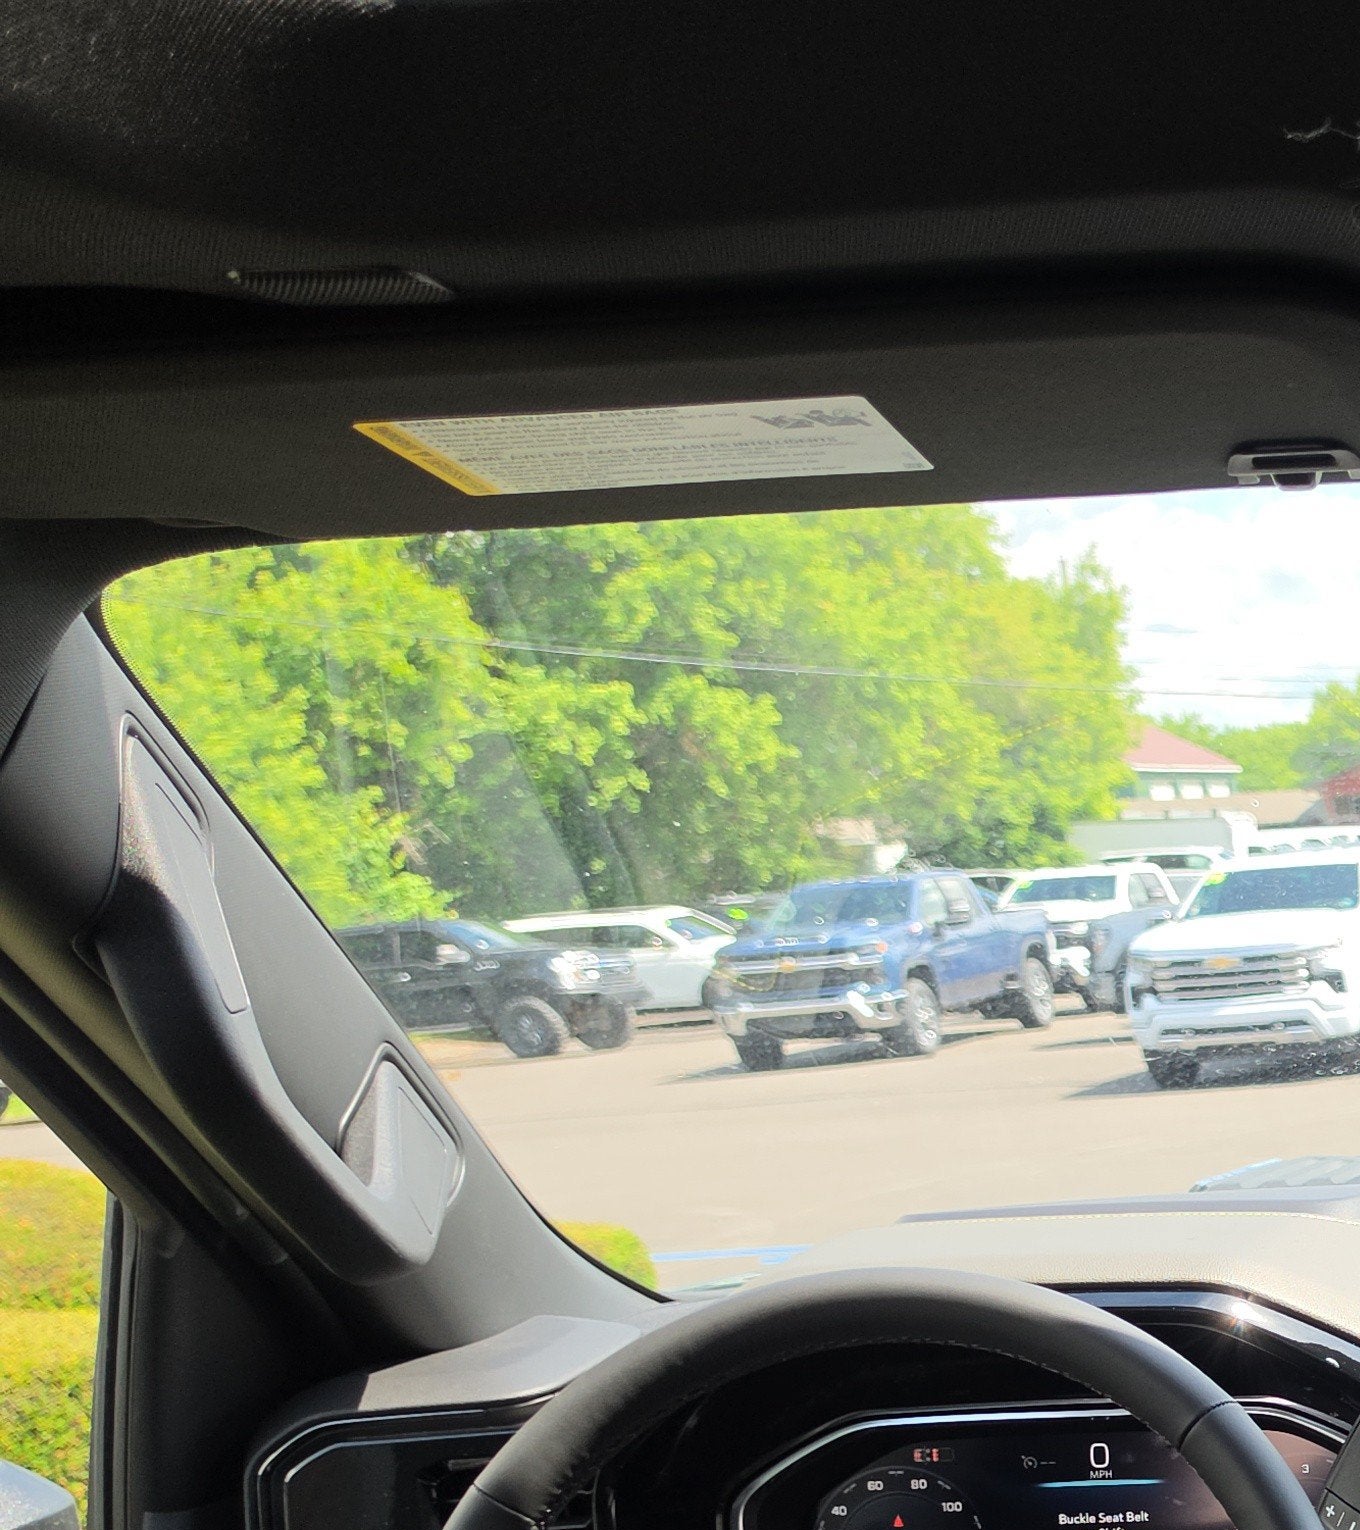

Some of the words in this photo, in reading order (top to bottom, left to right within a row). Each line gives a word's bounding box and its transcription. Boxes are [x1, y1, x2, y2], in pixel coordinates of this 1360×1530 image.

[1090, 1442, 1110, 1469] 0
[1089, 1470, 1113, 1479] MPH
[867, 1480, 884, 1491] 60
[910, 1479, 927, 1490] 80
[831, 1505, 848, 1516] 40
[941, 1501, 963, 1512] 100
[1058, 1513, 1096, 1525] Buckle
[1098, 1512, 1124, 1523] Seat
[1126, 1511, 1150, 1522] Belt
